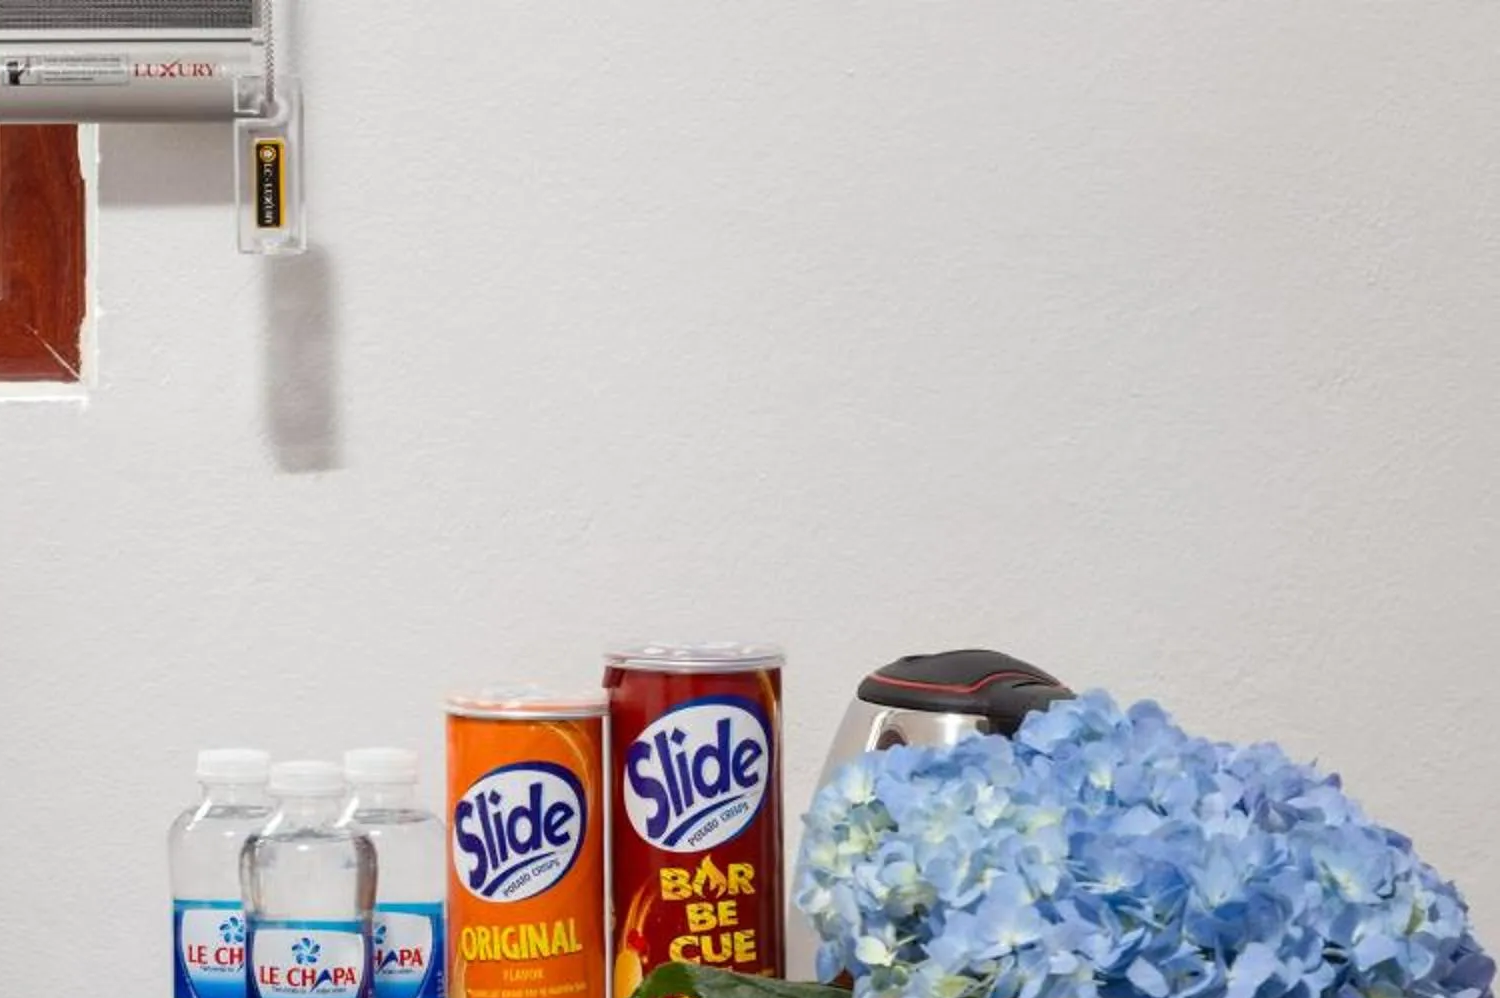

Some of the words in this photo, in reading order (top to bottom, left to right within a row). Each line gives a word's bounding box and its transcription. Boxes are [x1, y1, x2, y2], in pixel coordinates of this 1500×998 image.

[134, 59, 216, 78] LUXURY
[627, 717, 764, 840] Slide
[454, 783, 575, 891] Slide
[659, 854, 756, 901] BAR
[685, 900, 740, 933] BE
[188, 944, 208, 965] LE
[460, 917, 583, 962] ORIGINAL
[668, 930, 758, 965] CUE
[372, 948, 423, 974] HAPA
[260, 965, 280, 983] LE
[287, 967, 356, 992] CHAPA
